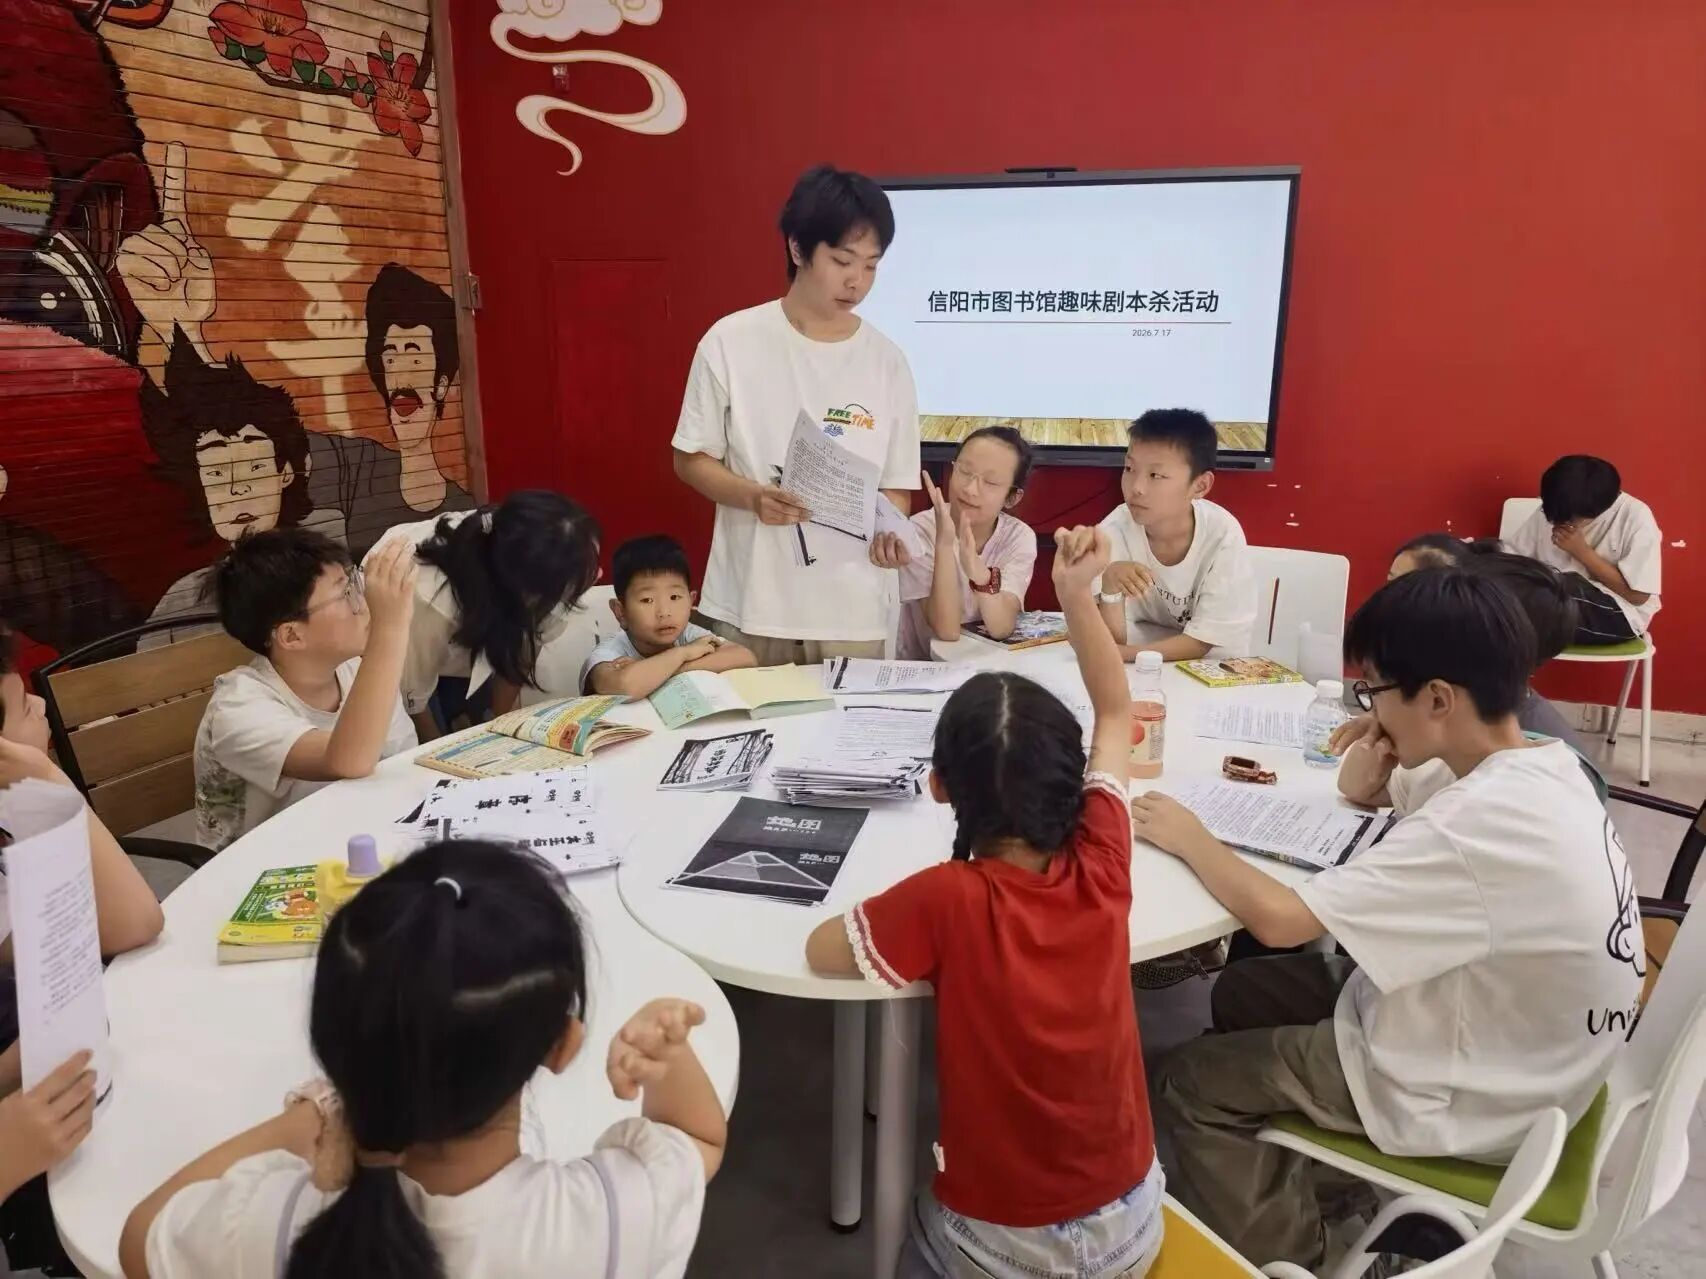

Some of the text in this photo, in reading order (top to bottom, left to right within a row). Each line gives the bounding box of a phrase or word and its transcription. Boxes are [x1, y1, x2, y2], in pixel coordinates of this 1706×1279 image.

[927, 289, 1220, 313] 信阳市图书馆趣味剧本杀活动
[827, 408, 851, 418] FREE
